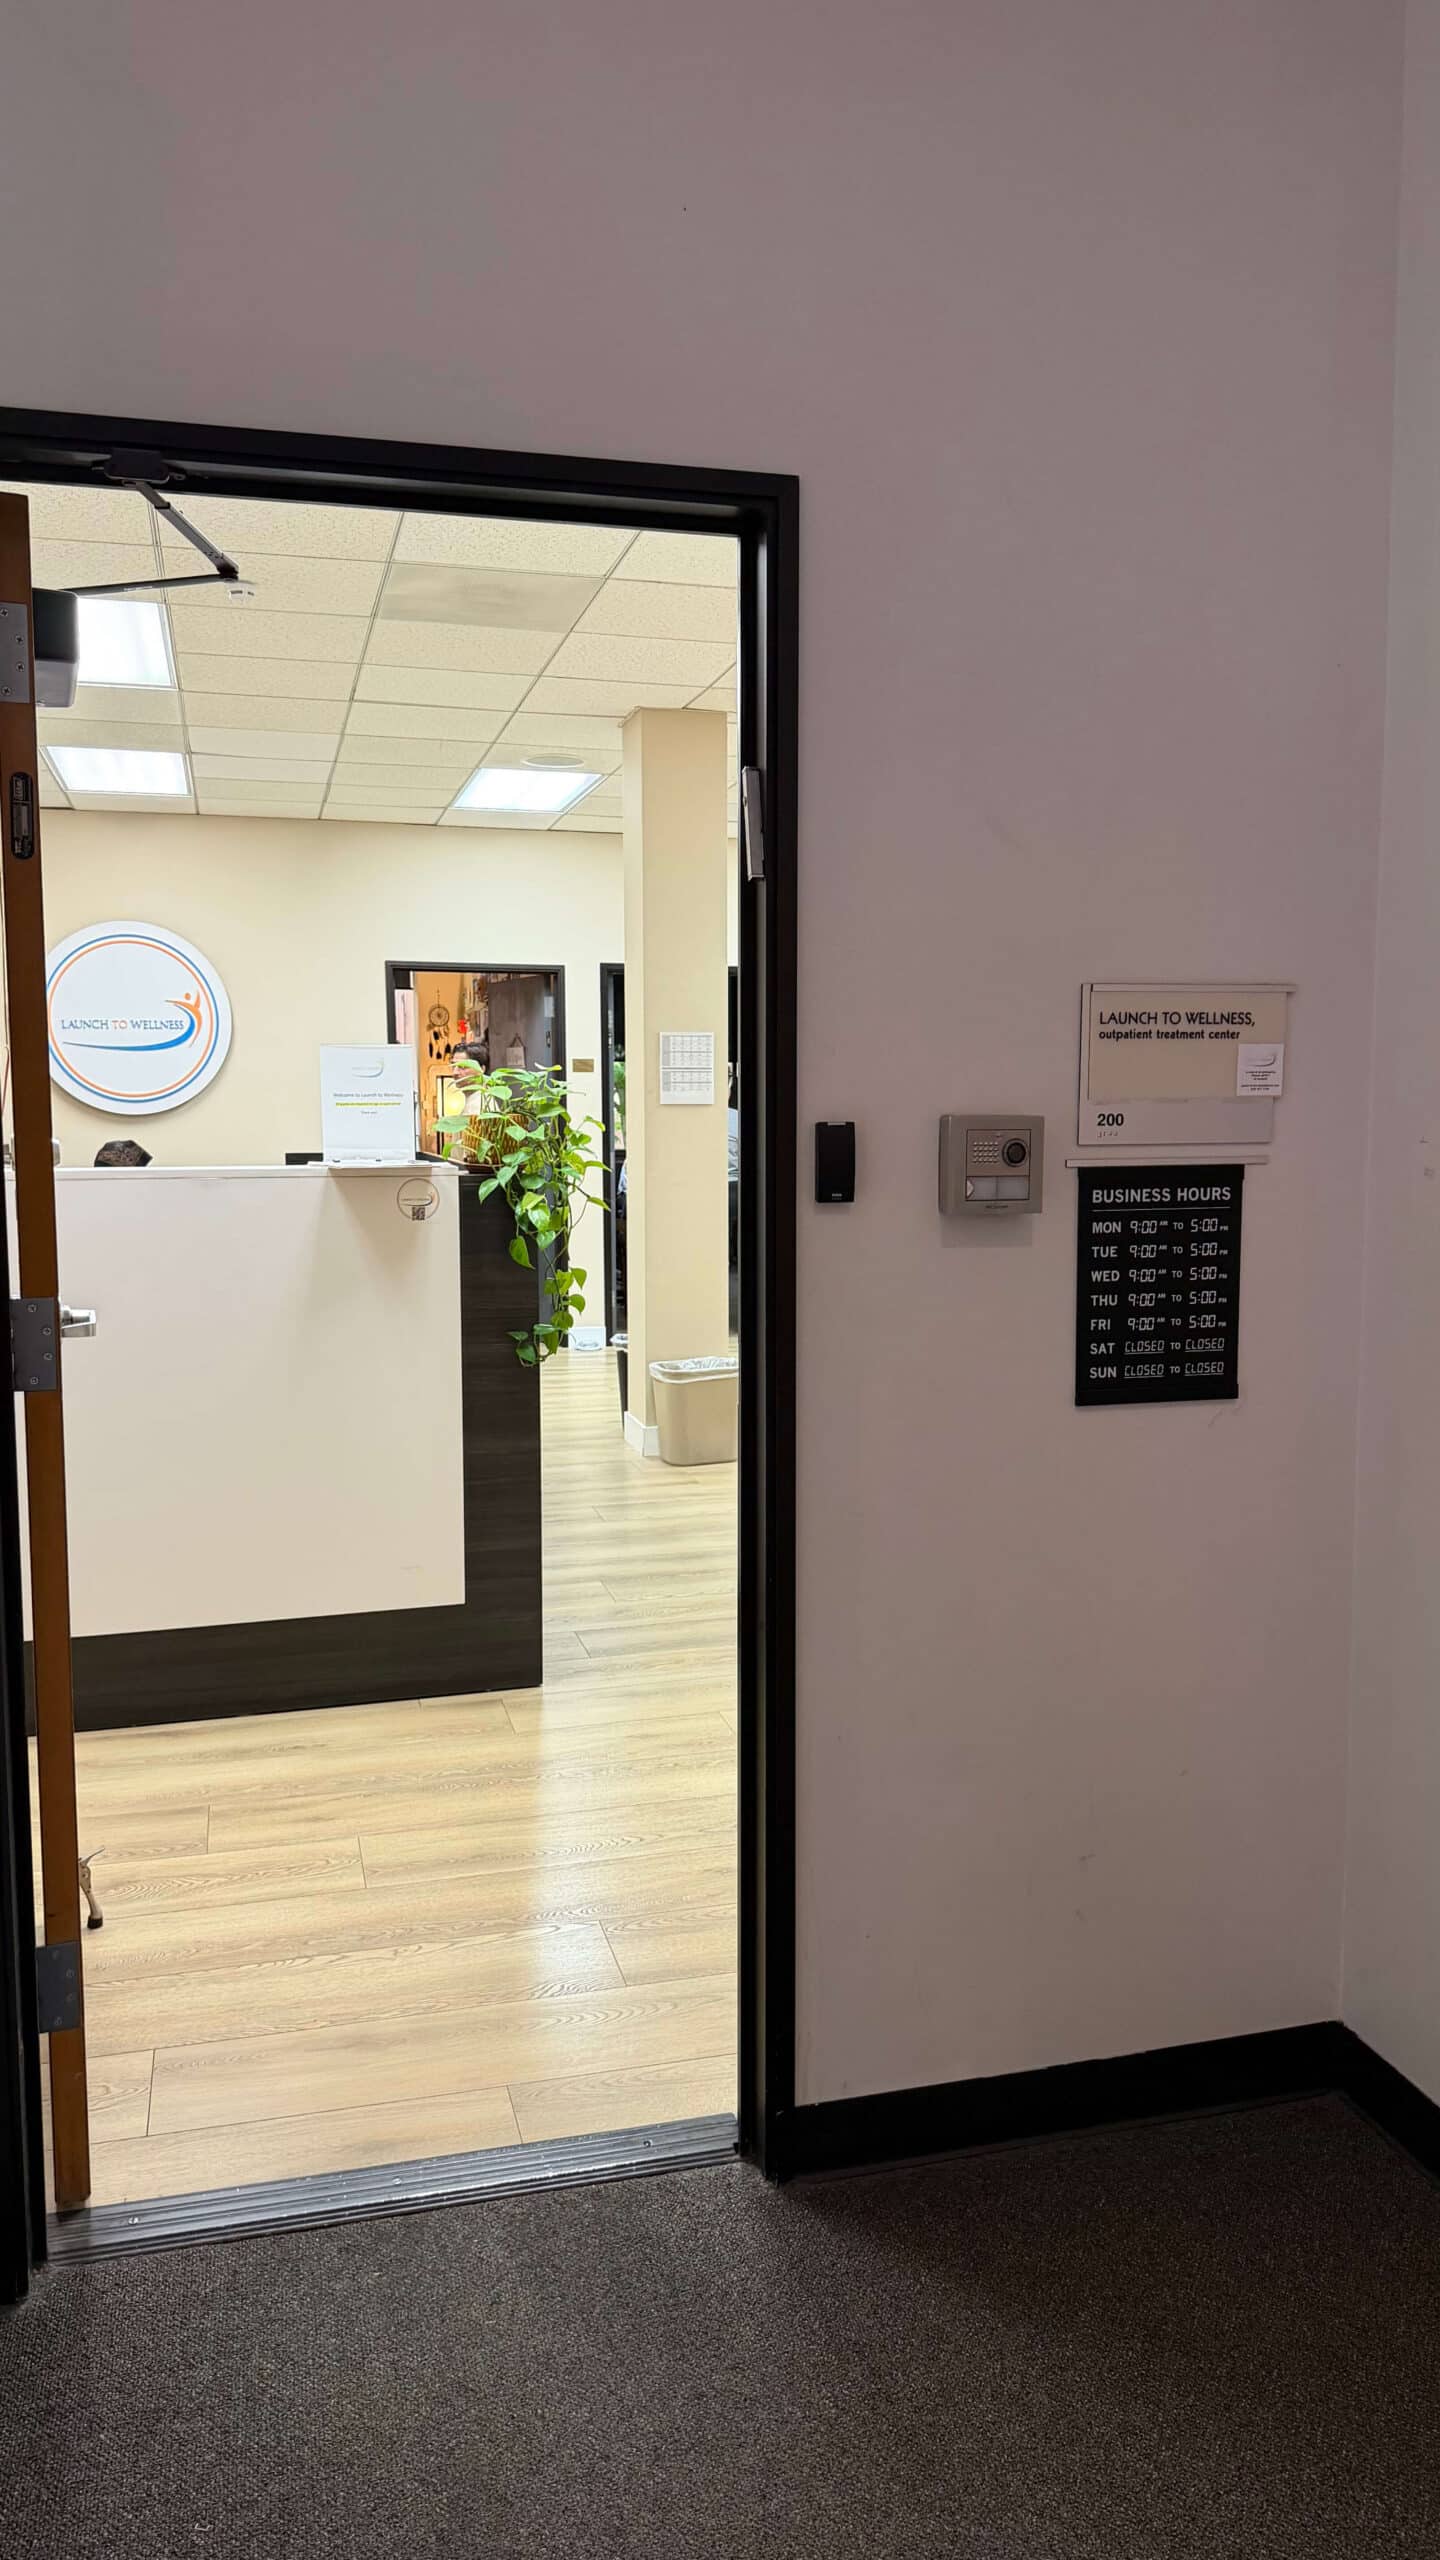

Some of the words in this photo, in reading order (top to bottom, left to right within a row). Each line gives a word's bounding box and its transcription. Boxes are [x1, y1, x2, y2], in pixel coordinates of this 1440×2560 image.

[61, 1019, 109, 1030] LAUNCH
[112, 1019, 128, 1030] TO
[130, 1019, 184, 1030] WELLNESS
[1100, 1012, 1157, 1024] LAUNCH
[1162, 1012, 1181, 1025] TO
[1185, 1012, 1255, 1027] WELLNESS,
[1099, 1029, 1152, 1042] outpatient
[1157, 1029, 1204, 1039] treatment
[1209, 1030, 1240, 1039] center
[1097, 1113, 1124, 1126] 200
[1093, 1188, 1170, 1203] BUSINESS
[1178, 1187, 1231, 1201] HOURS
[1092, 1221, 1121, 1234] MON
[1130, 1220, 1157, 1234] 9:00
[1173, 1222, 1183, 1230] TO
[1191, 1218, 1218, 1232] 5:00
[1092, 1246, 1118, 1258] TUE
[1130, 1245, 1157, 1258] 9:00
[1172, 1246, 1183, 1254] TO
[1191, 1242, 1218, 1256] 5:00
[1091, 1270, 1120, 1282] WED
[1129, 1269, 1156, 1282] 9:00
[1172, 1270, 1182, 1278] TO
[1190, 1266, 1217, 1280] 5:00
[1091, 1295, 1117, 1306] THU
[1128, 1293, 1155, 1306] 9:00
[1189, 1291, 1216, 1304] 5:00
[1091, 1319, 1110, 1330] FRI
[1128, 1317, 1155, 1331] 9:00
[1171, 1318, 1181, 1326] TO
[1189, 1315, 1216, 1328] 5:00
[1090, 1343, 1115, 1354] SAT
[1125, 1340, 1164, 1353] CLOSED
[1170, 1342, 1181, 1350] TO
[1185, 1338, 1224, 1350] CLOSED
[1090, 1366, 1116, 1378] SUN
[1124, 1364, 1164, 1376] CLOSED
[1185, 1362, 1224, 1374] CLOSED
